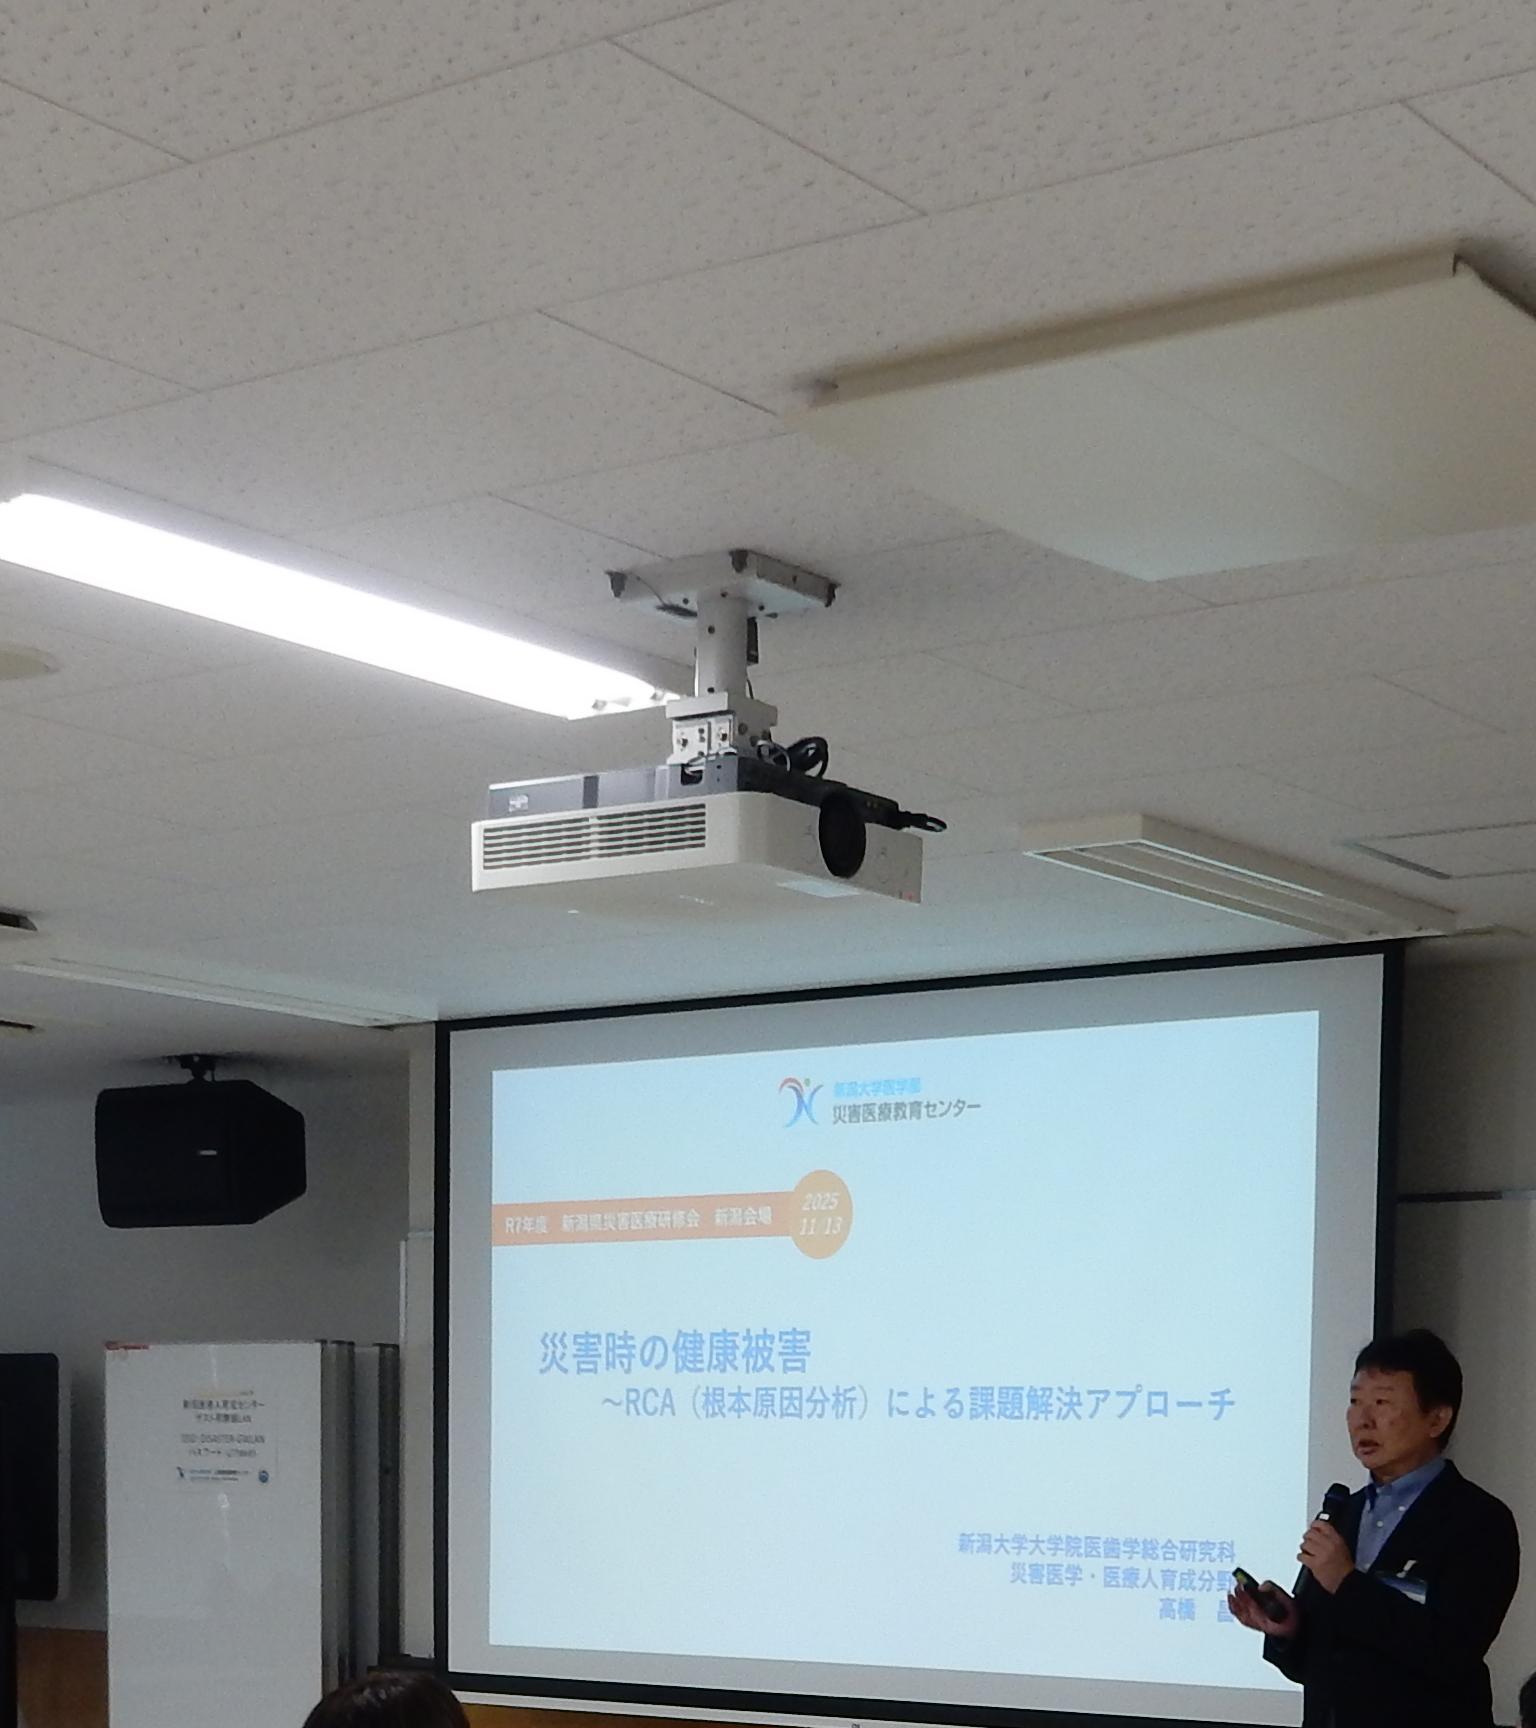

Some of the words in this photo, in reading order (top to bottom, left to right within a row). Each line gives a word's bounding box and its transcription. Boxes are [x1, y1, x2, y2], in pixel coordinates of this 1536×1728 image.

[832, 1098, 982, 1126] 災害医療教育センター
[800, 1191, 841, 1212] 2025
[538, 1327, 812, 1376] 災害時の健康被害
[958, 1532, 1236, 1563] 新潟大学大学院医歯学総合研究科
